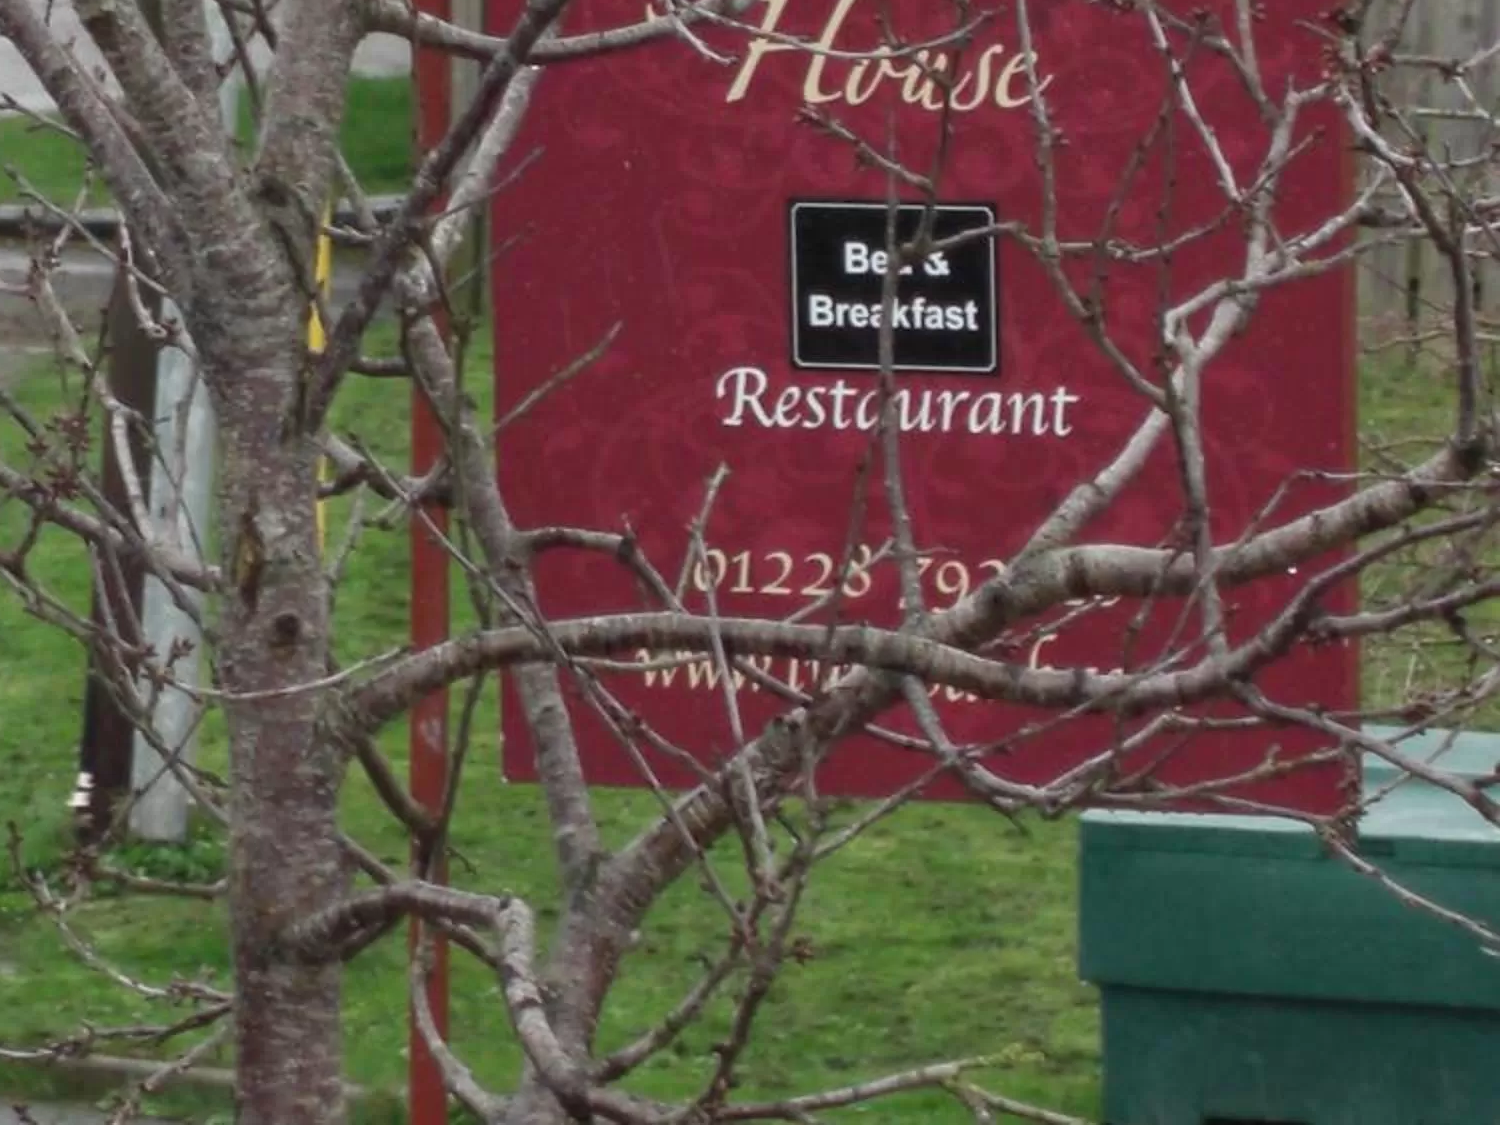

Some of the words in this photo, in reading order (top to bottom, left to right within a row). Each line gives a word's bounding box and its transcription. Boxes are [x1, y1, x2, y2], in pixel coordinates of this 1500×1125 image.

[843, 241, 913, 275] Be
[808, 294, 979, 331] Breakfast
[715, 366, 1079, 436] Restaurant
[694, 544, 872, 597] 01228
